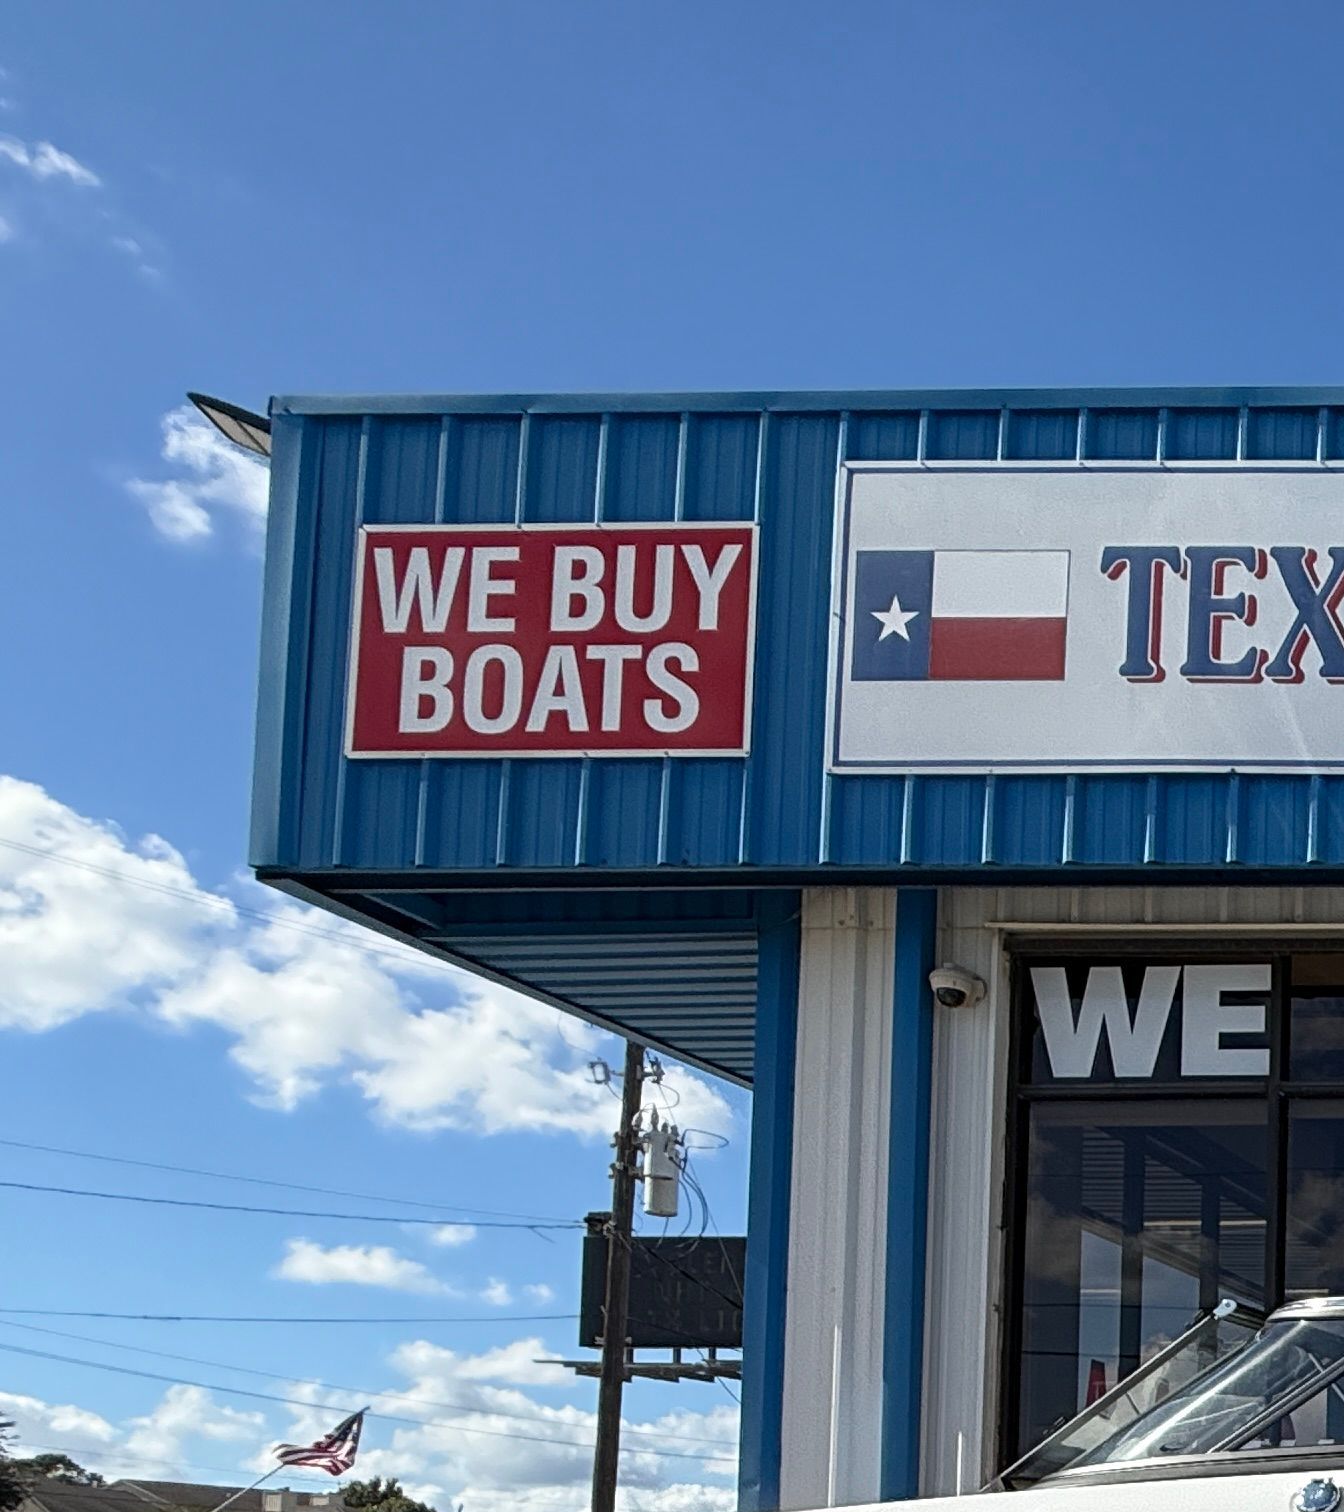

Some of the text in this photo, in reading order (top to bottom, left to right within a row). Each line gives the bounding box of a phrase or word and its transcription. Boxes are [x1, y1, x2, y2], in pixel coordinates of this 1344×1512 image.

[374, 544, 743, 633] WE BUY
[399, 642, 700, 734] BOATS
[1030, 964, 1271, 1078] WE
